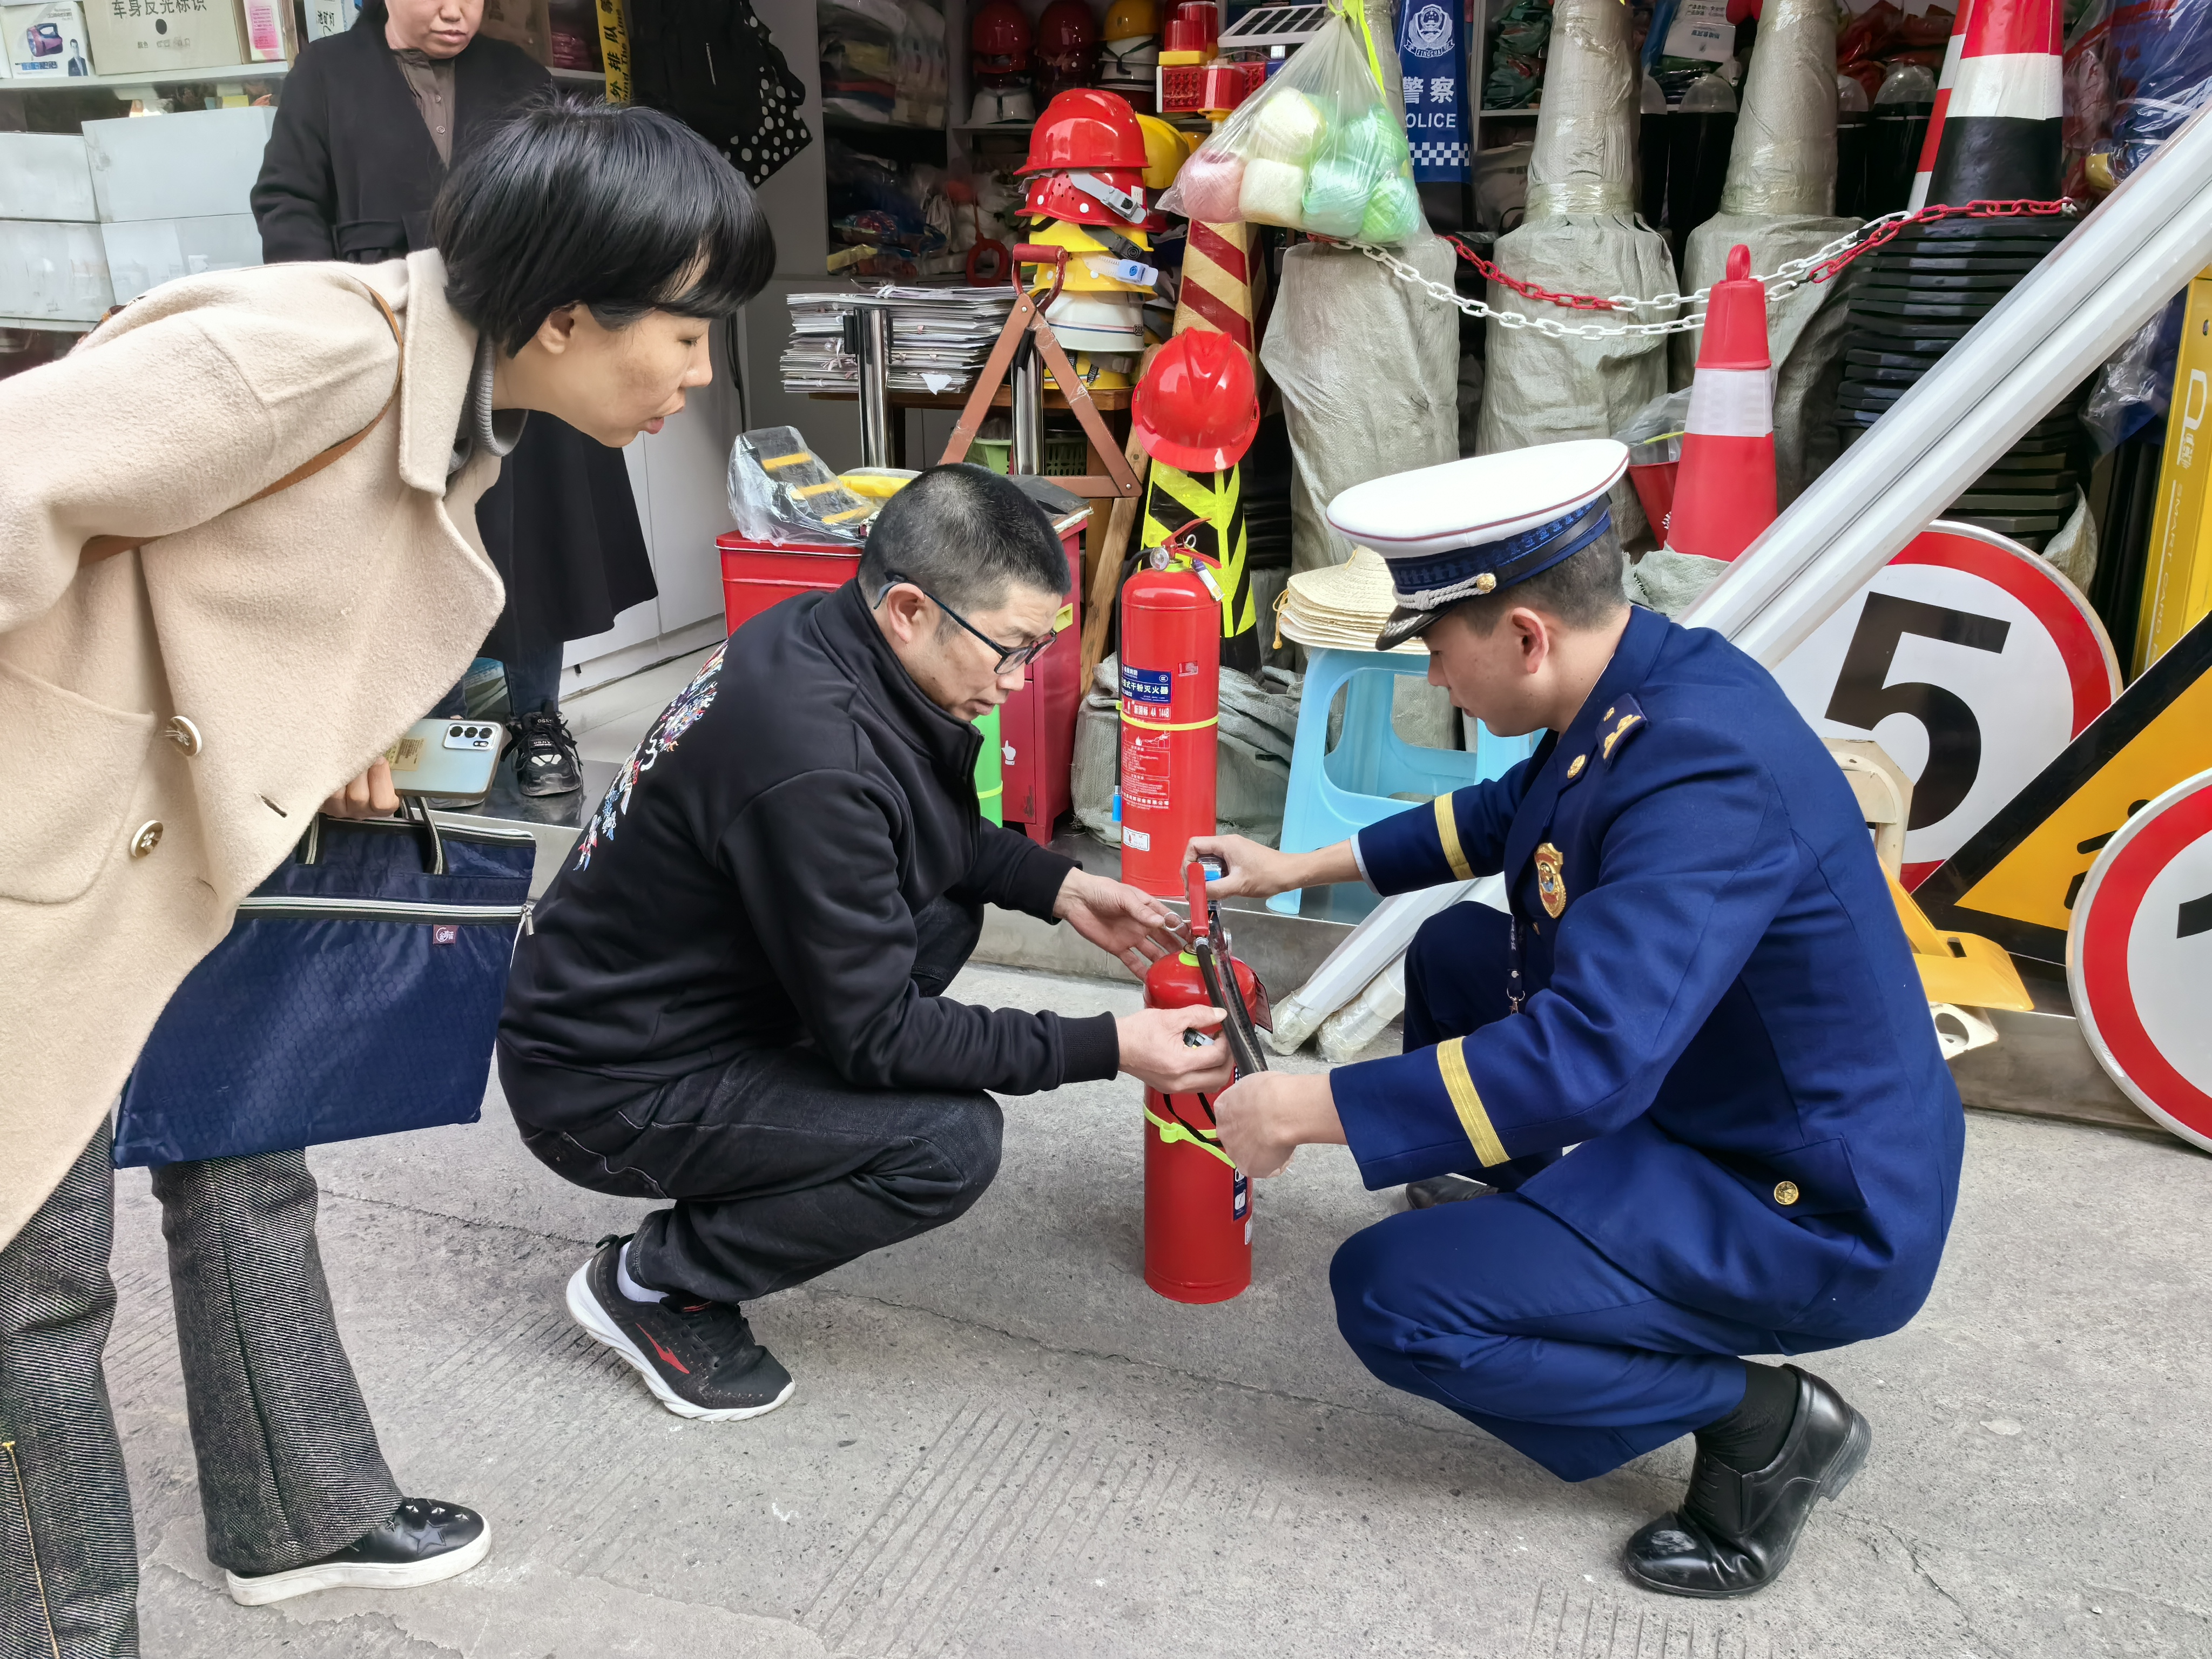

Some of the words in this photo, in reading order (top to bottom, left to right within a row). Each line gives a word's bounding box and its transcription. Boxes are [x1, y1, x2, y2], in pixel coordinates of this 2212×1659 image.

[111, 0, 207, 19] 车身反光标识
[1403, 76, 1454, 104] 警察
[1406, 113, 1456, 128] OLICE
[1825, 591, 2011, 831] 5
